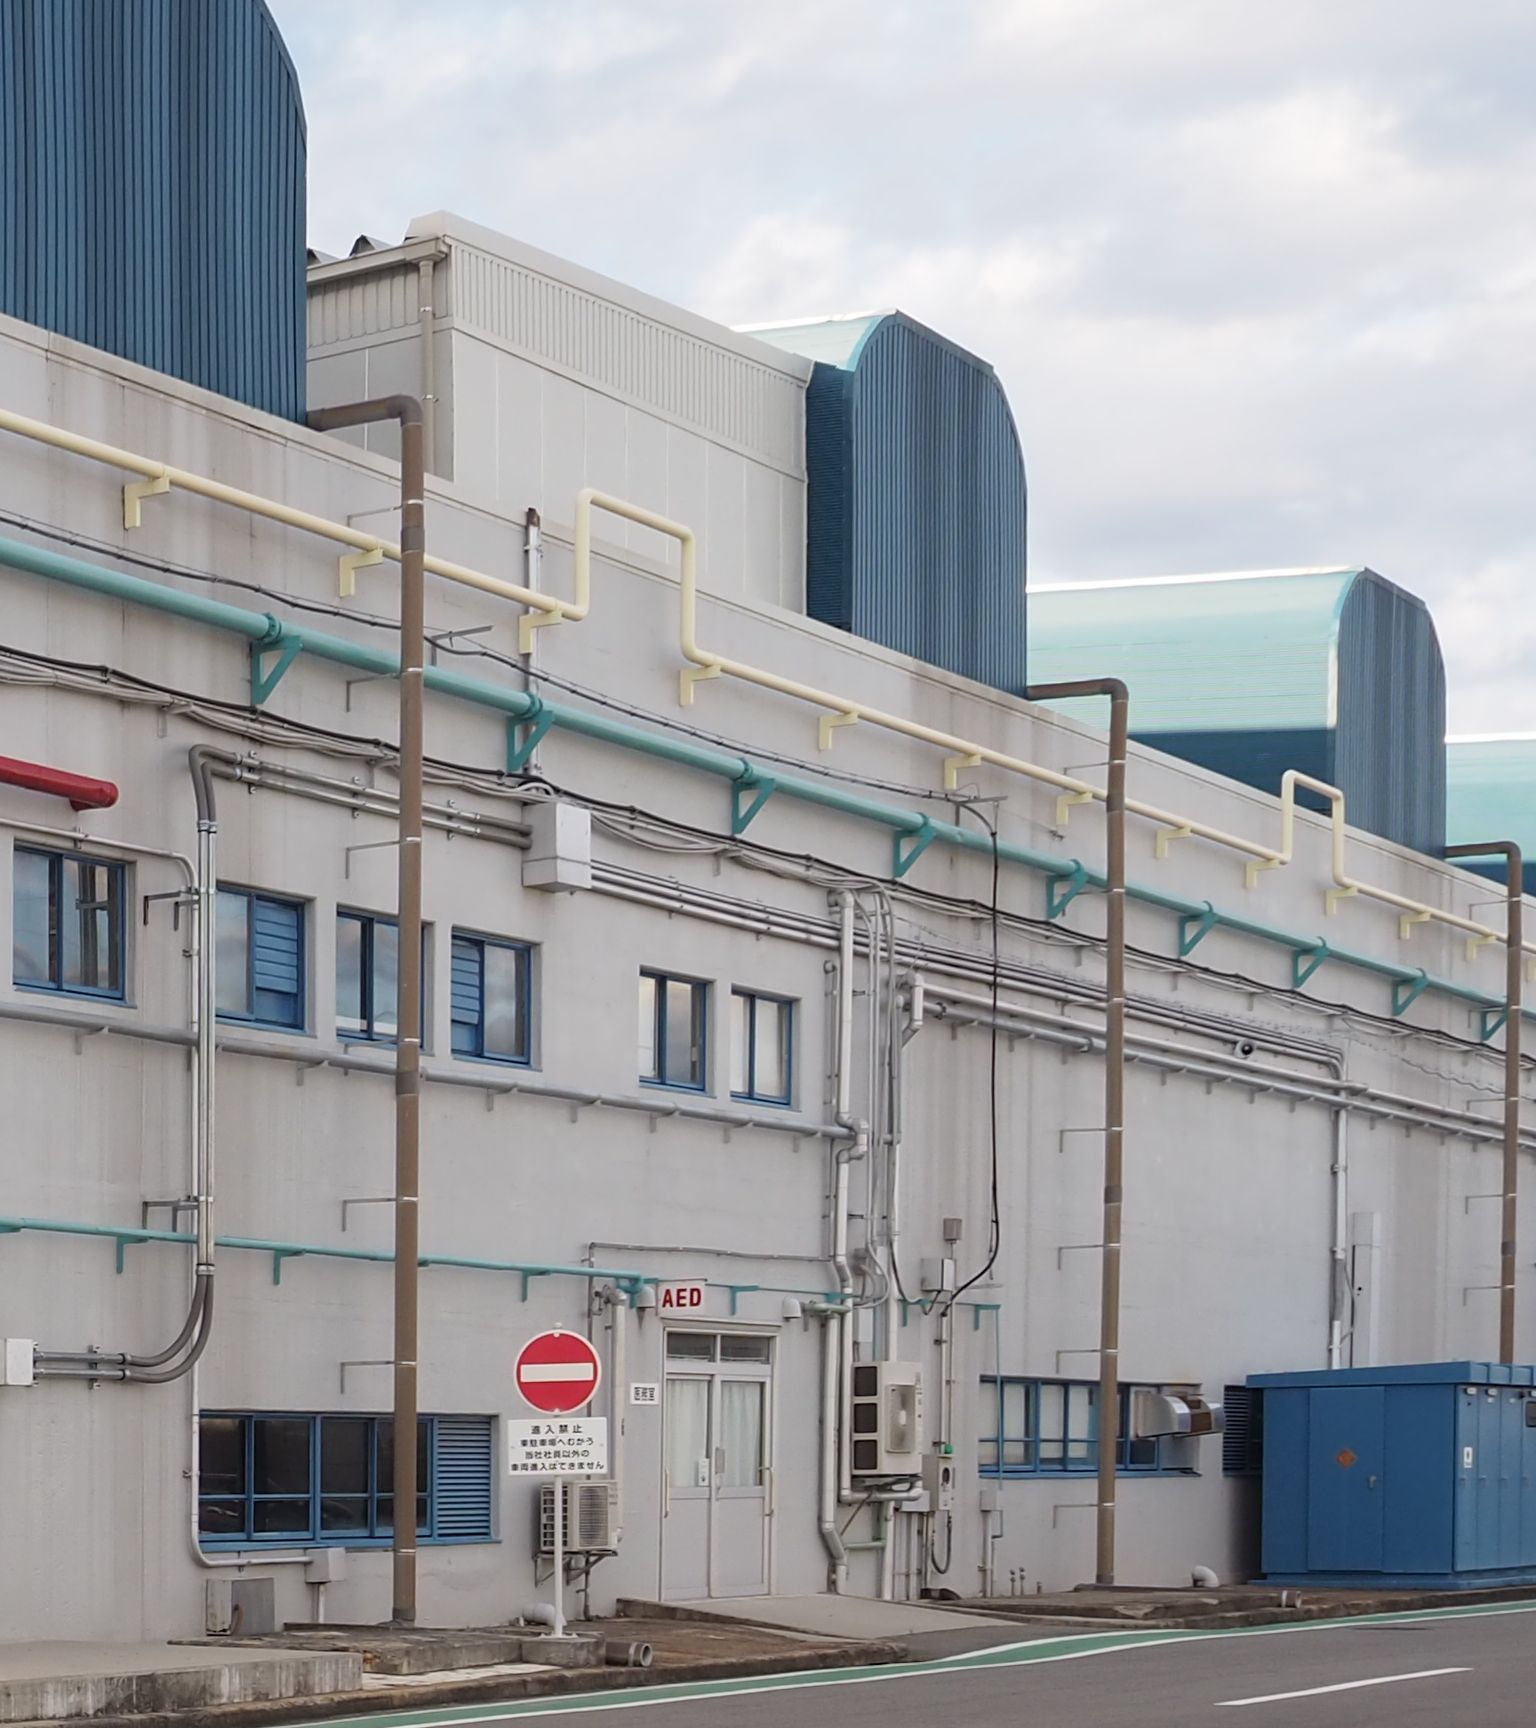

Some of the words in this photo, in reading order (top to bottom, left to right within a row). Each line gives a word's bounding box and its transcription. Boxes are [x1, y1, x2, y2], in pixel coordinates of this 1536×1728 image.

[661, 1288, 702, 1308] AED
[531, 1424, 583, 1435] 進入禁止
